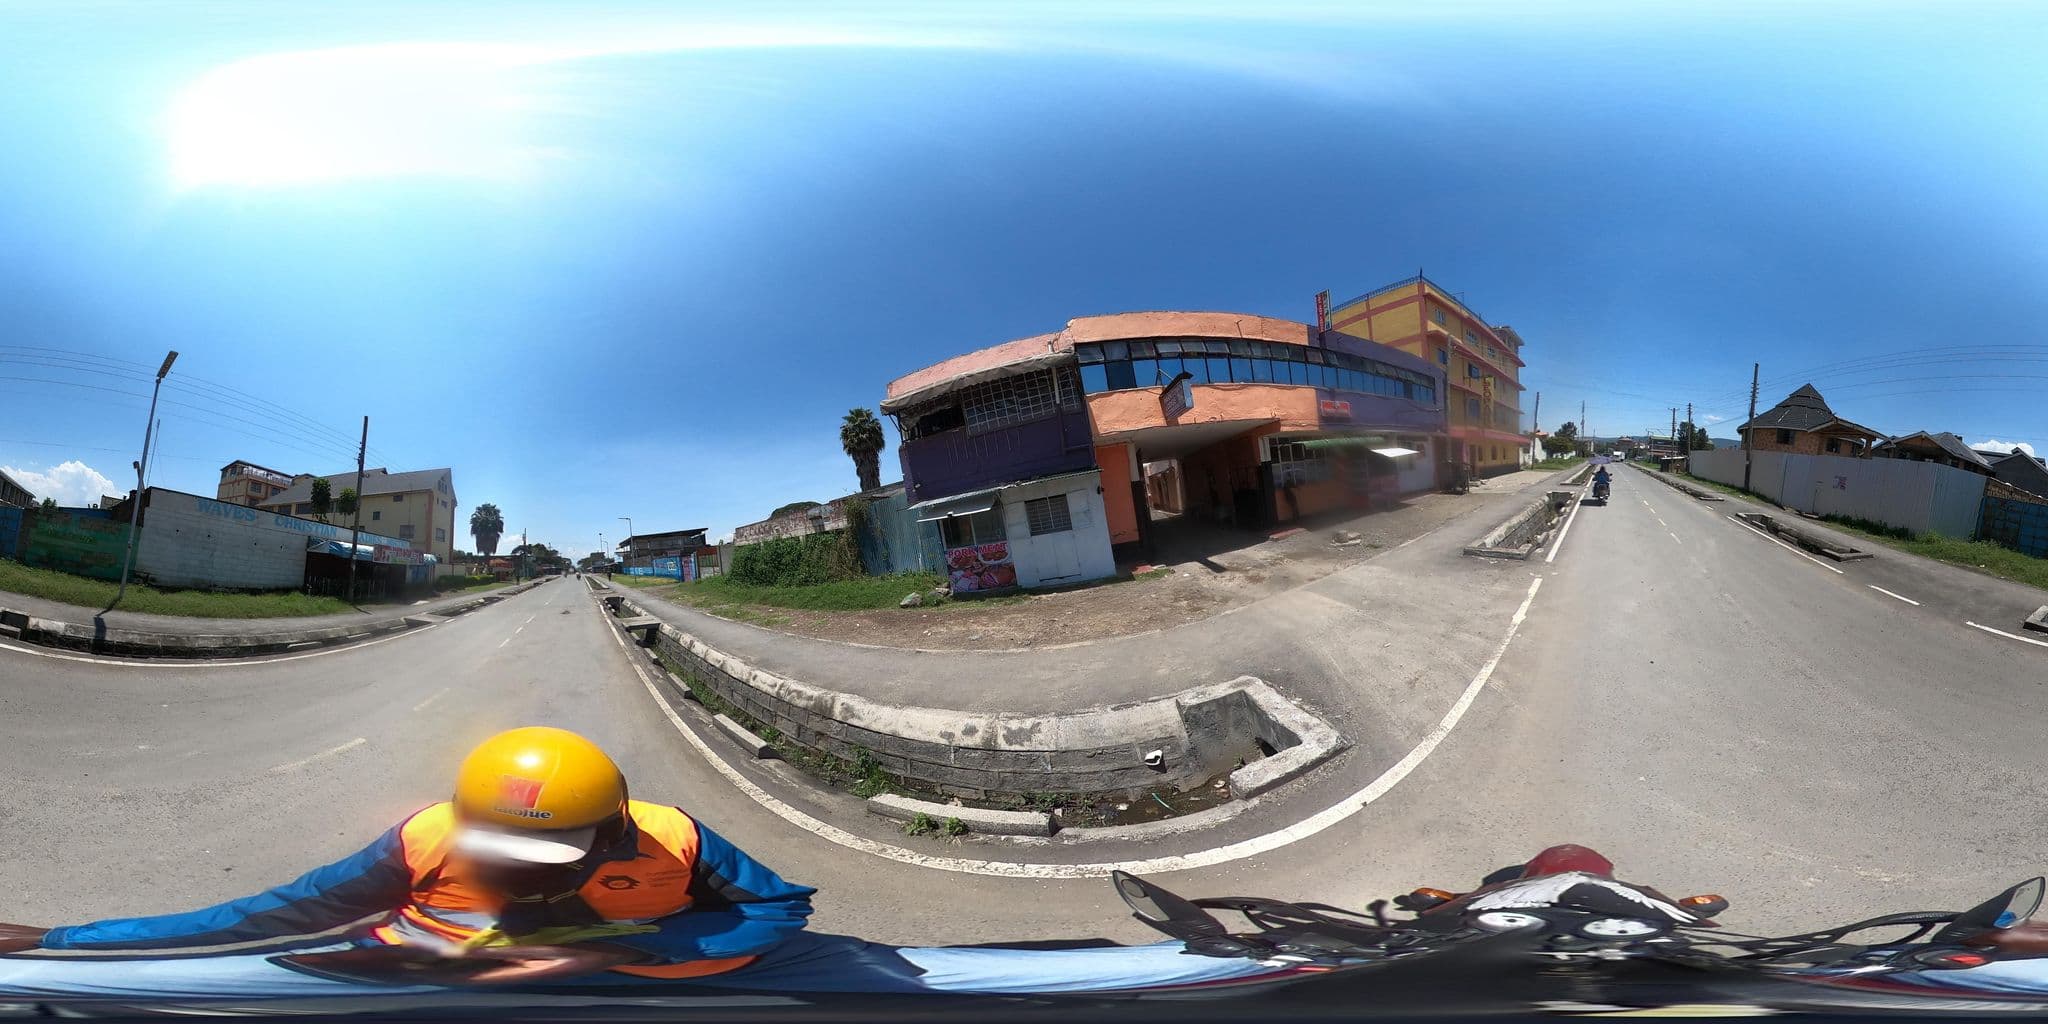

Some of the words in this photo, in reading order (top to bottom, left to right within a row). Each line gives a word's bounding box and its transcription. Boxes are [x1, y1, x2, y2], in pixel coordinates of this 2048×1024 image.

[197, 499, 255, 521] WAVES
[274, 514, 337, 538] CHRISTIAN
[358, 532, 383, 546] ADIES
[979, 543, 1007, 553] MEAT
